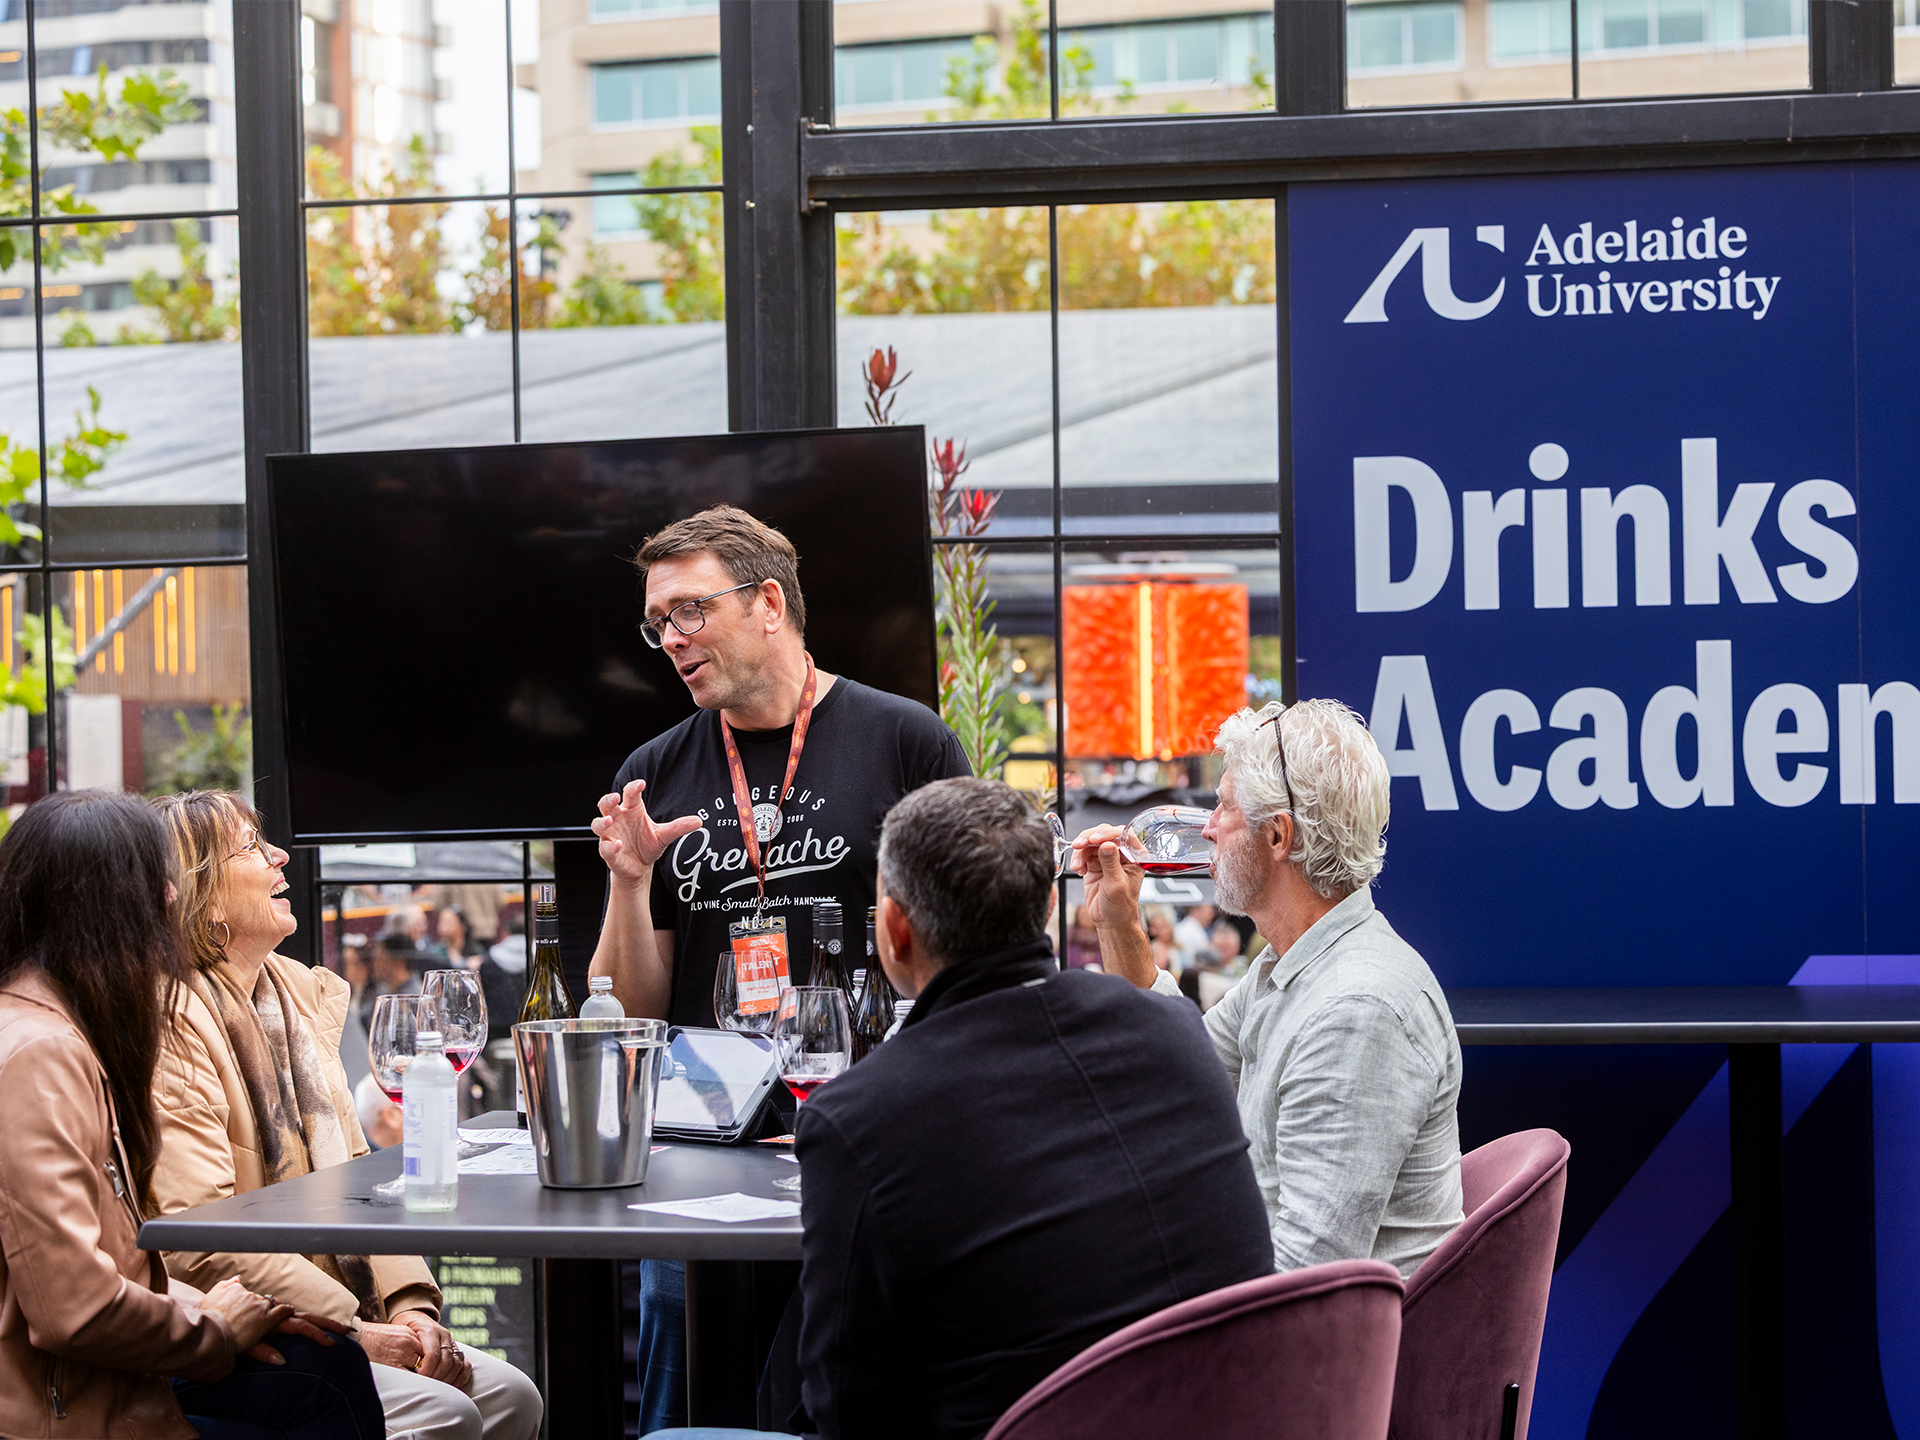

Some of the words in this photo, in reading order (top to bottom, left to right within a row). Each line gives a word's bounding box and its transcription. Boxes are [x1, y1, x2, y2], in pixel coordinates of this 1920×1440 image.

[1525, 216, 1748, 266] Adelaide
[1525, 266, 1781, 321] University
[1353, 437, 1859, 613] Drinks
[697, 785, 826, 821] GOGEOUS
[717, 818, 738, 827] ESTD
[703, 899, 720, 910] VINE
[721, 897, 758, 912] Small
[759, 894, 793, 910] Batch
